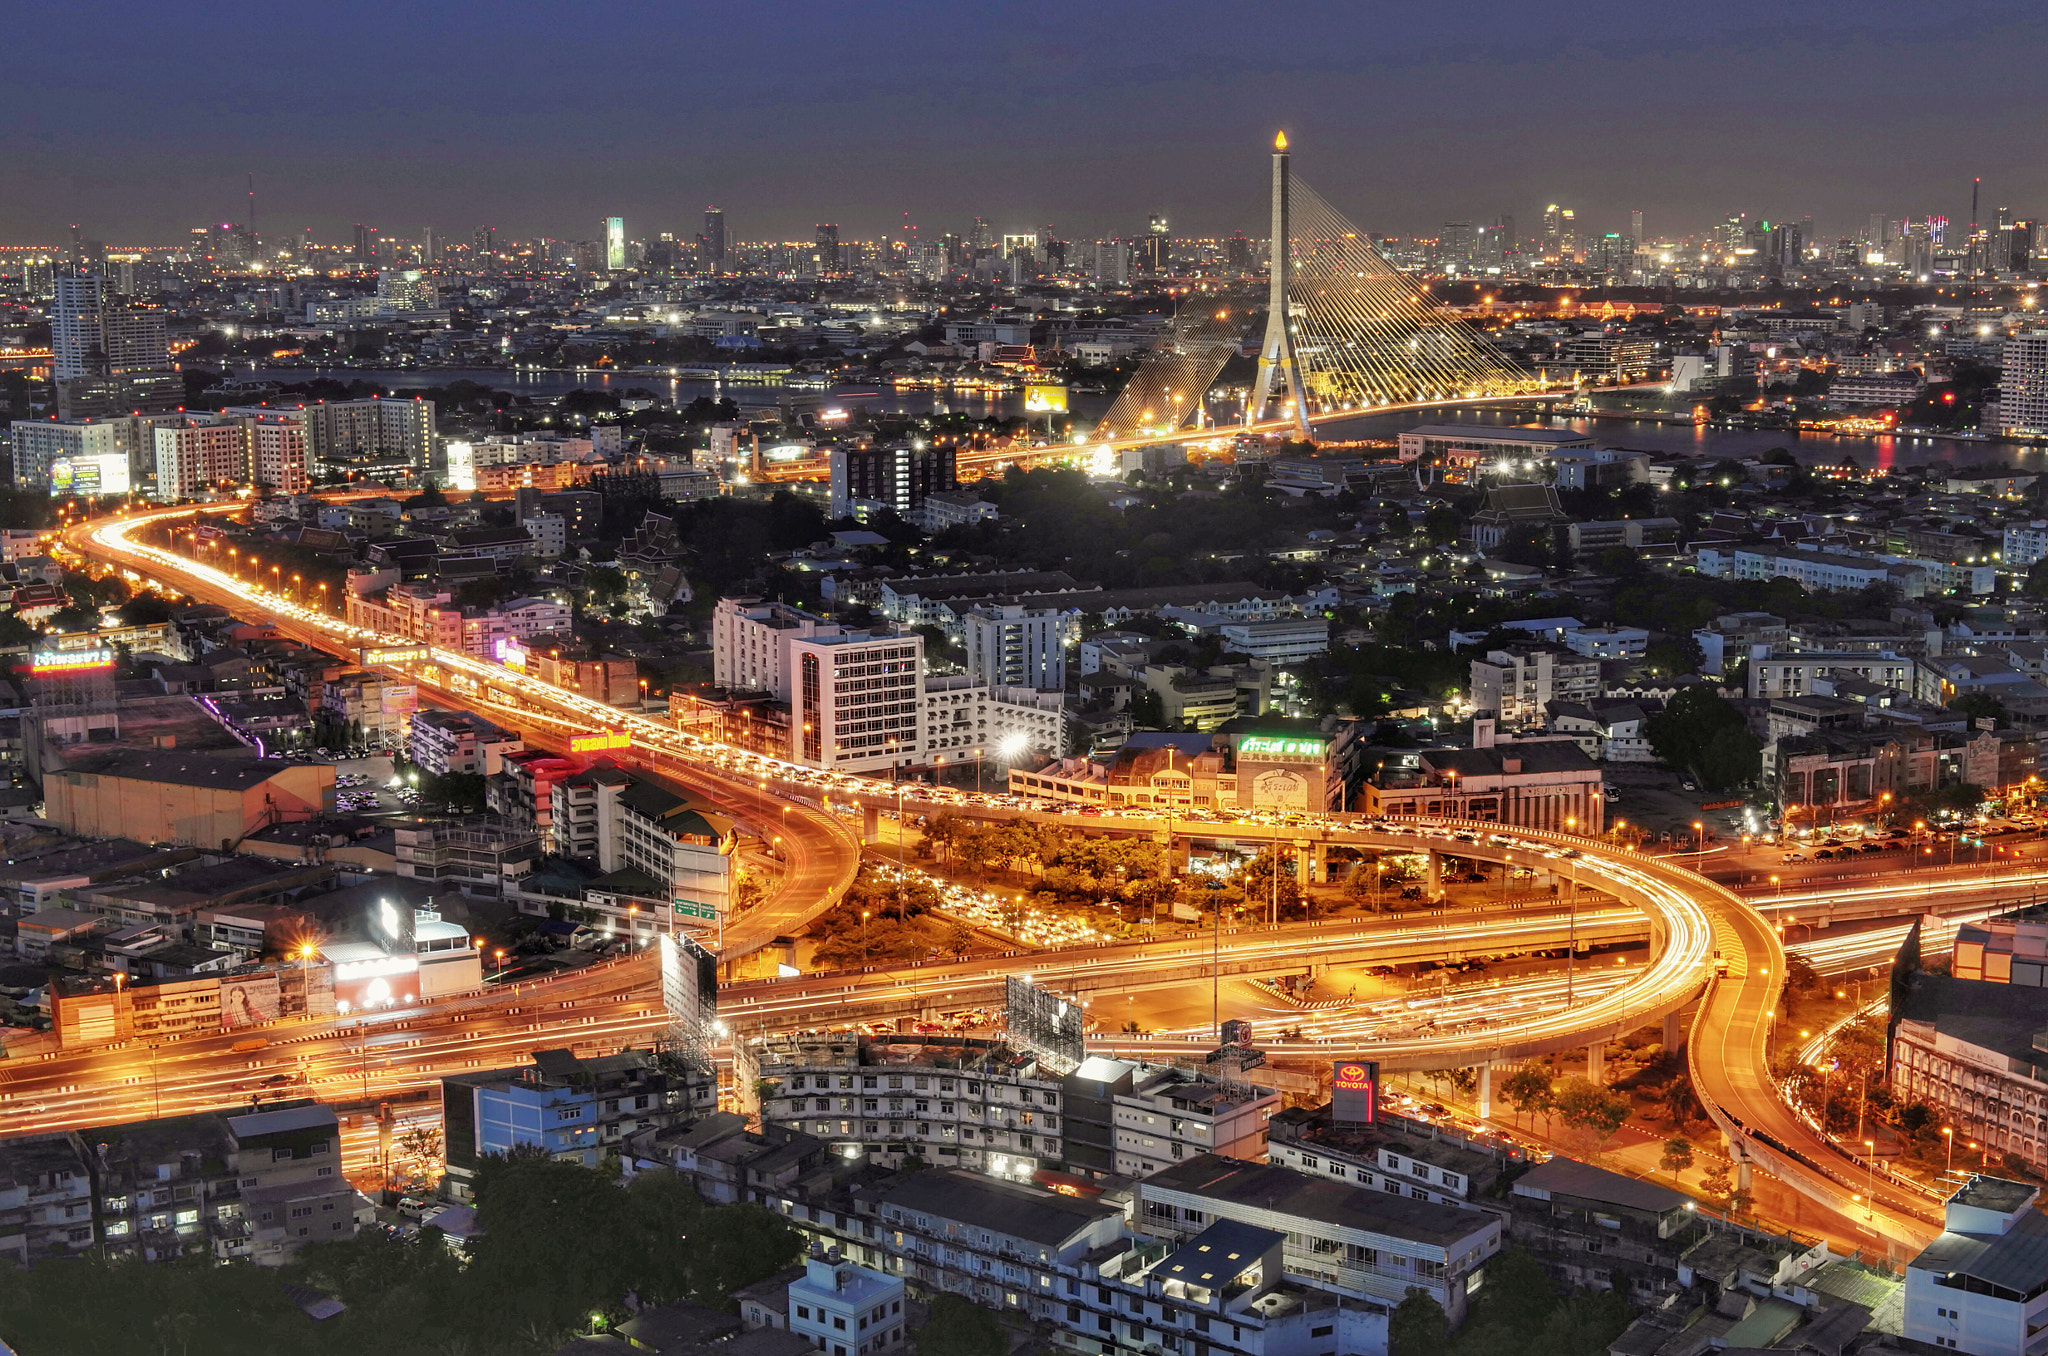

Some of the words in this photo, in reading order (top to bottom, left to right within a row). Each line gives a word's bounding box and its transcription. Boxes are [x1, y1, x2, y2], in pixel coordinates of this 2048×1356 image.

[102, 651, 111, 661] 3
[420, 649, 427, 659] 3
[1336, 1080, 1368, 1089] TOYOTA
